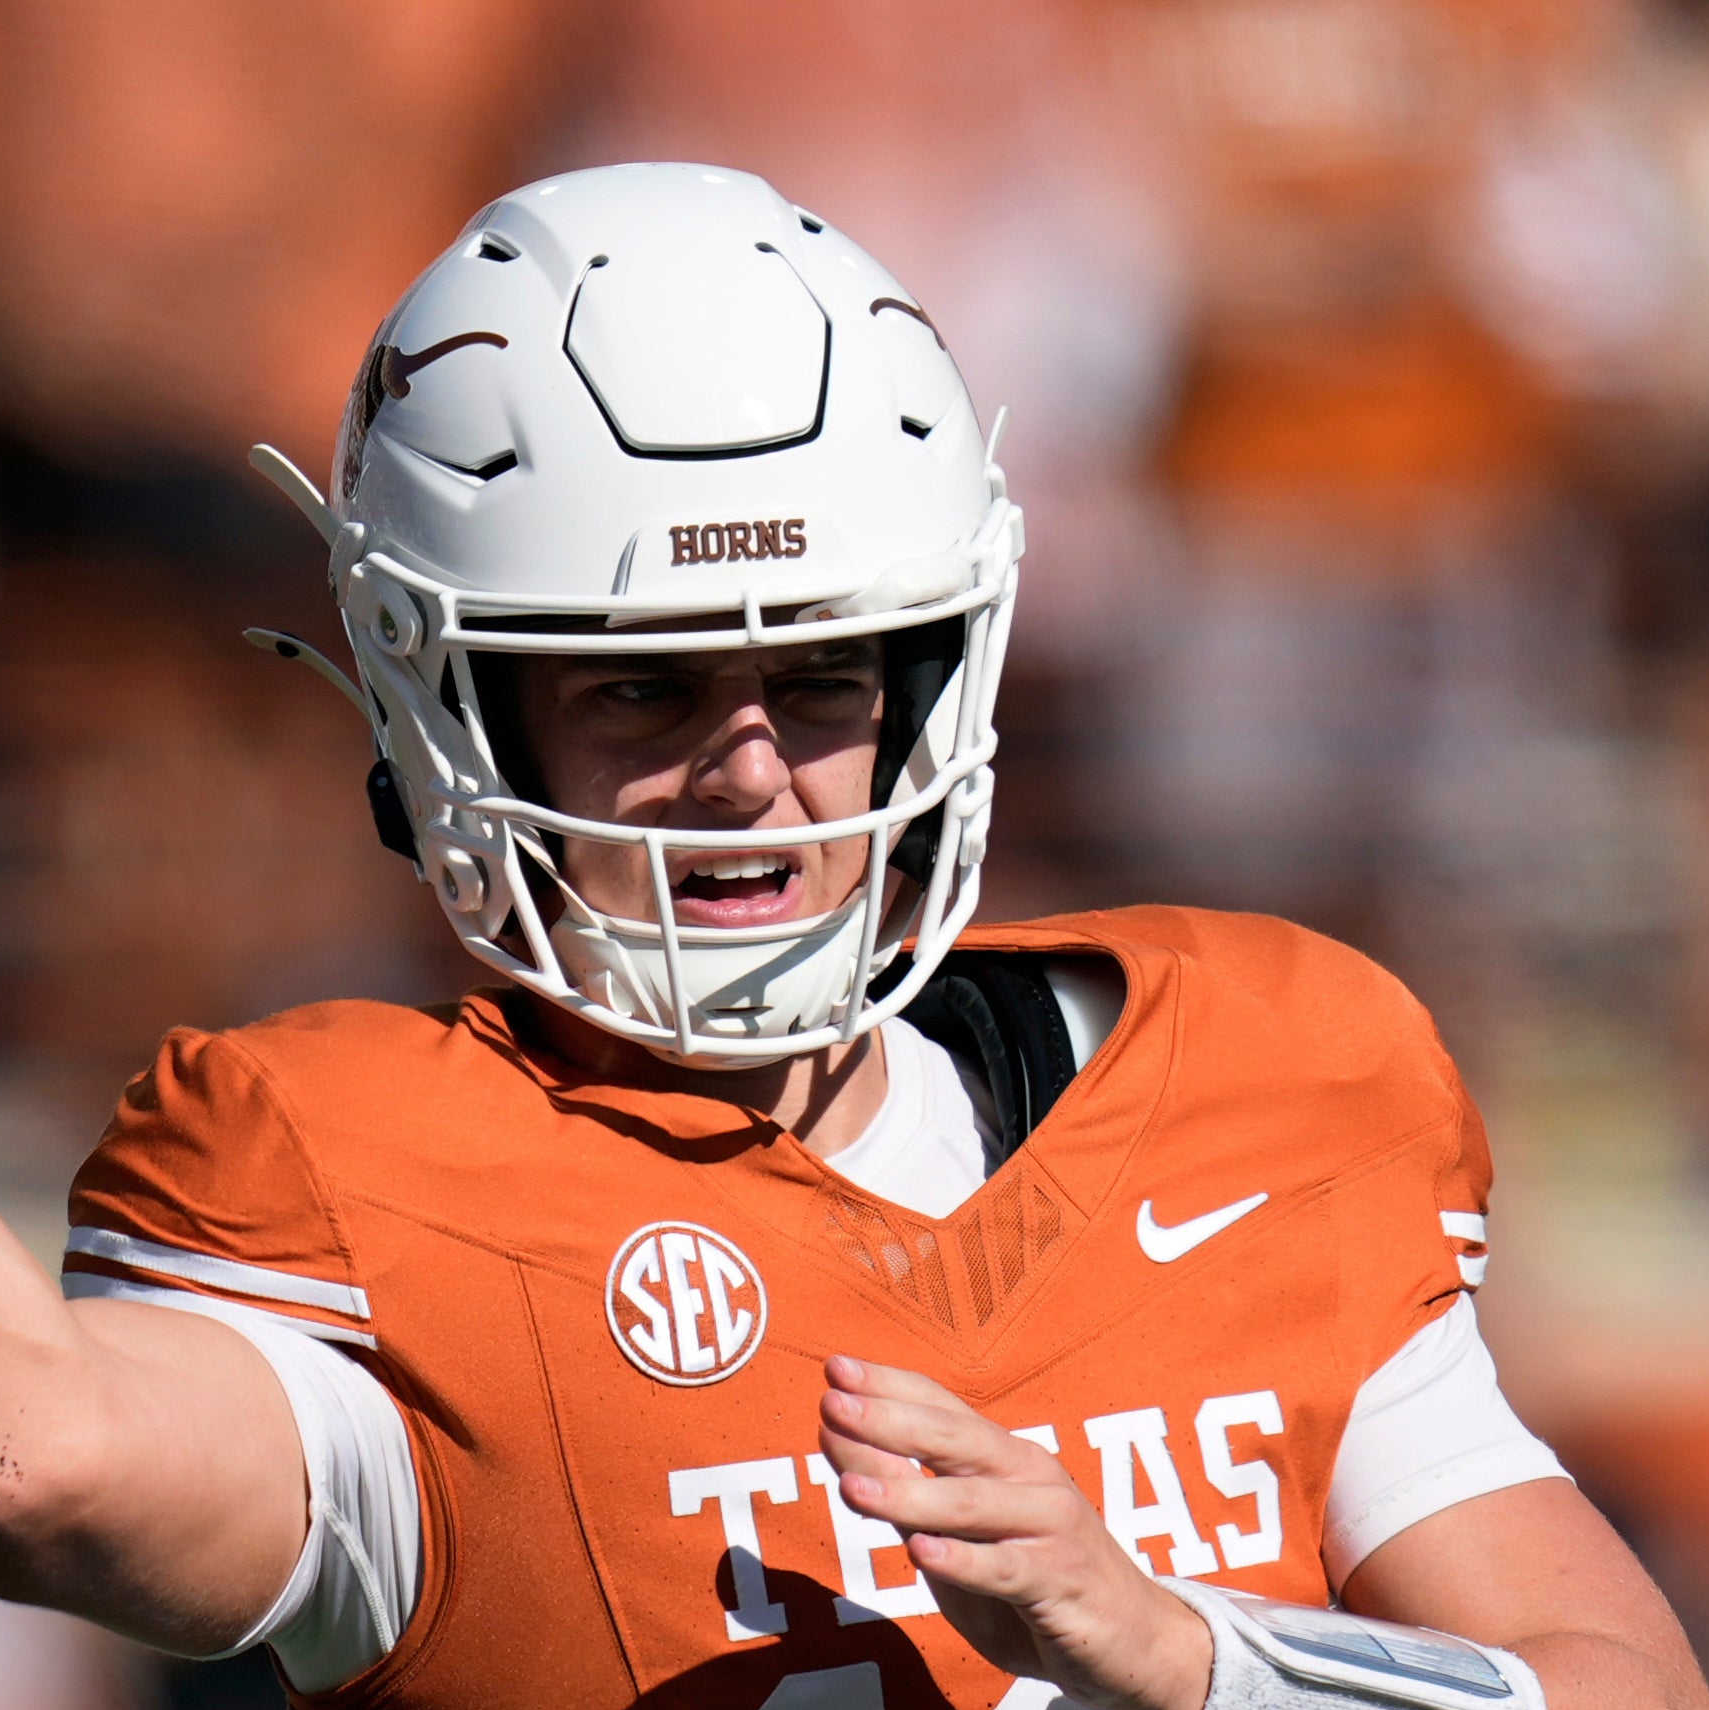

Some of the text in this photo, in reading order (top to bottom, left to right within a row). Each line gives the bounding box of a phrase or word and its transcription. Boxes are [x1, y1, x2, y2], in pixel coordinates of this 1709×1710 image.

[669, 519, 807, 566] HORNS
[619, 1231, 754, 1373] SEC
[668, 1390, 1284, 1642] TEAS
